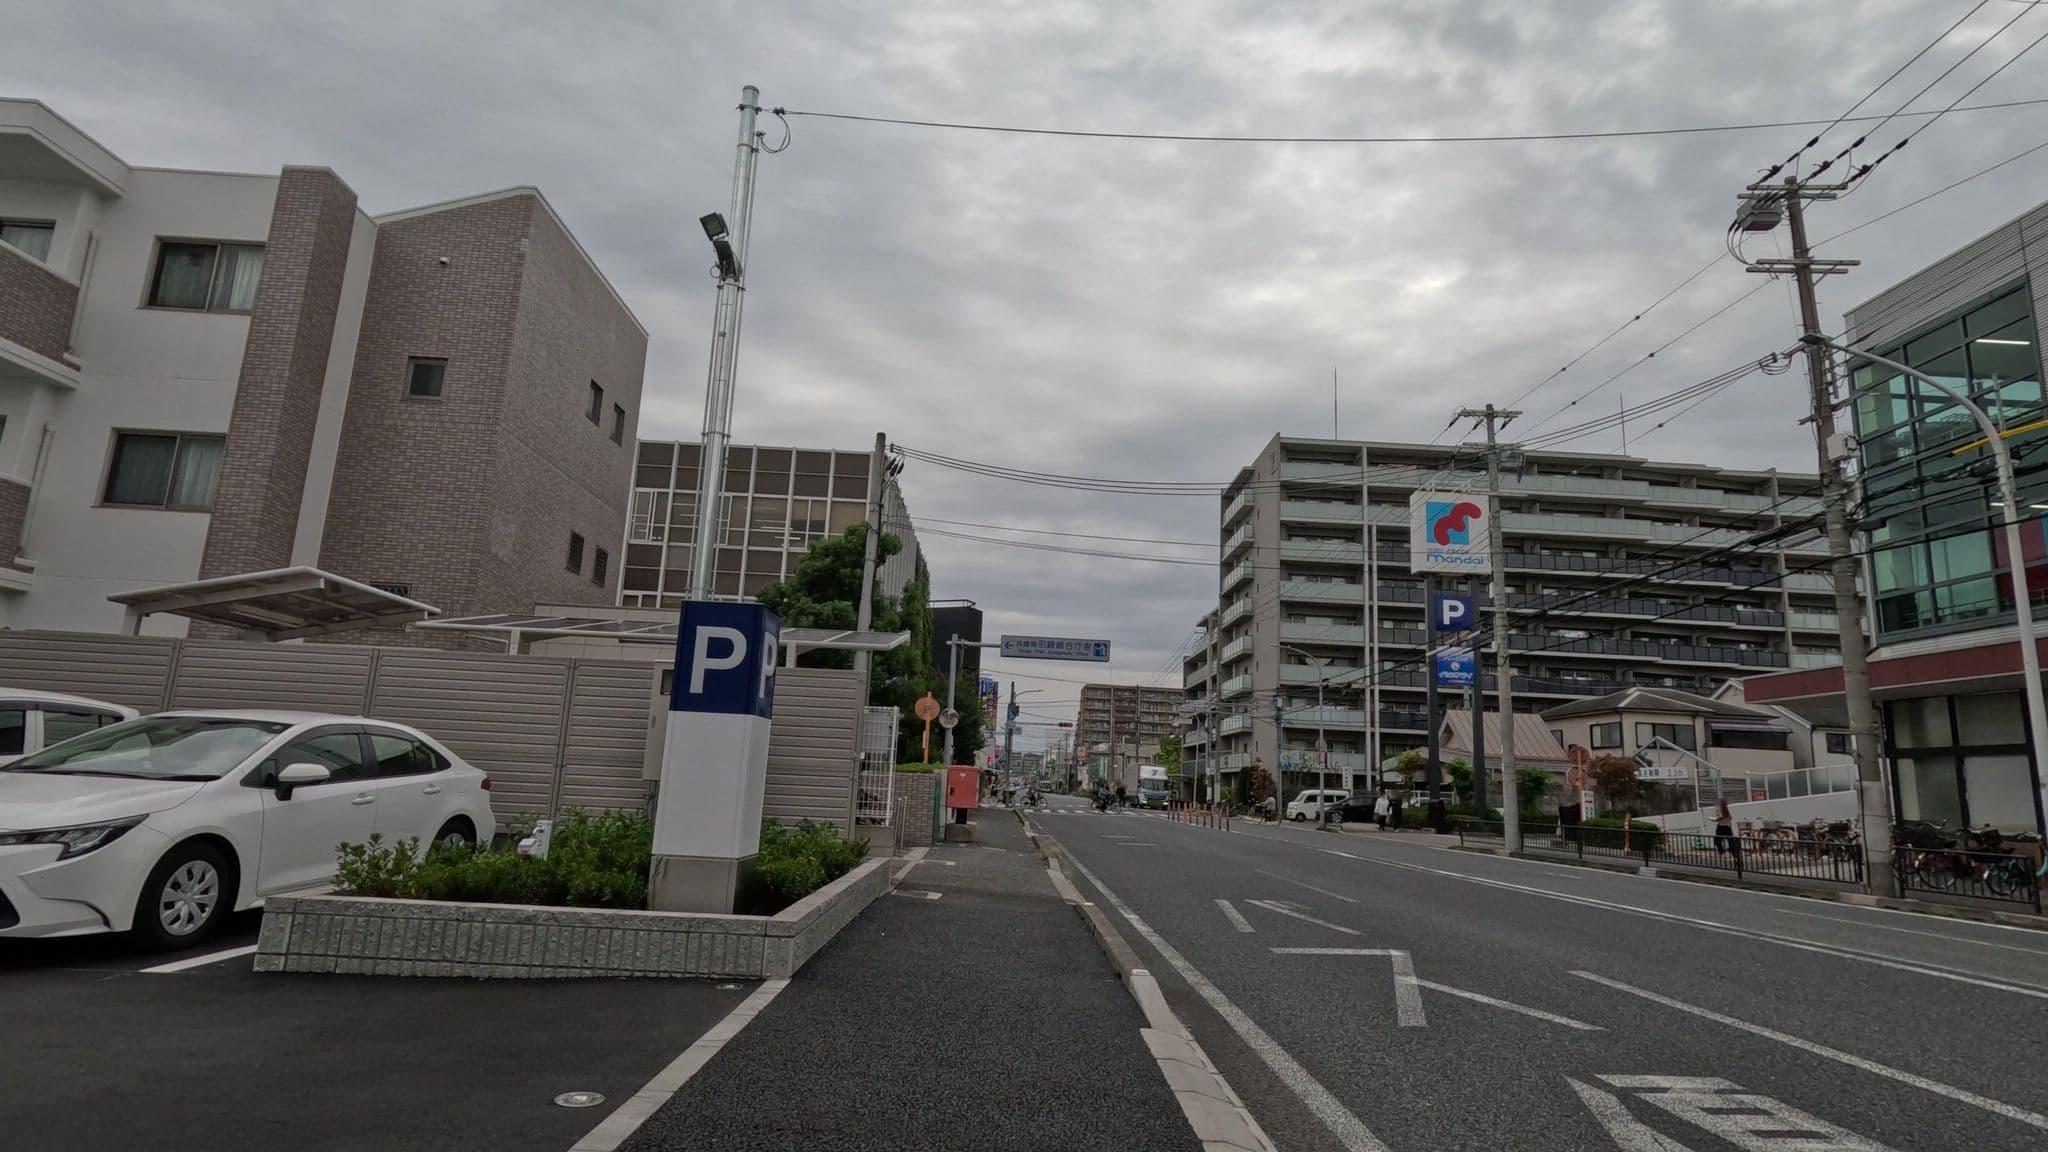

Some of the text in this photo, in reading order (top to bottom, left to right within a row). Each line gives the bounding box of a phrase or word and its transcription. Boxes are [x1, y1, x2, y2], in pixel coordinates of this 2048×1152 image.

[1427, 554, 1483, 564] mandai
[1442, 599, 1465, 625] P
[689, 625, 747, 694] P
[759, 631, 778, 699] P
